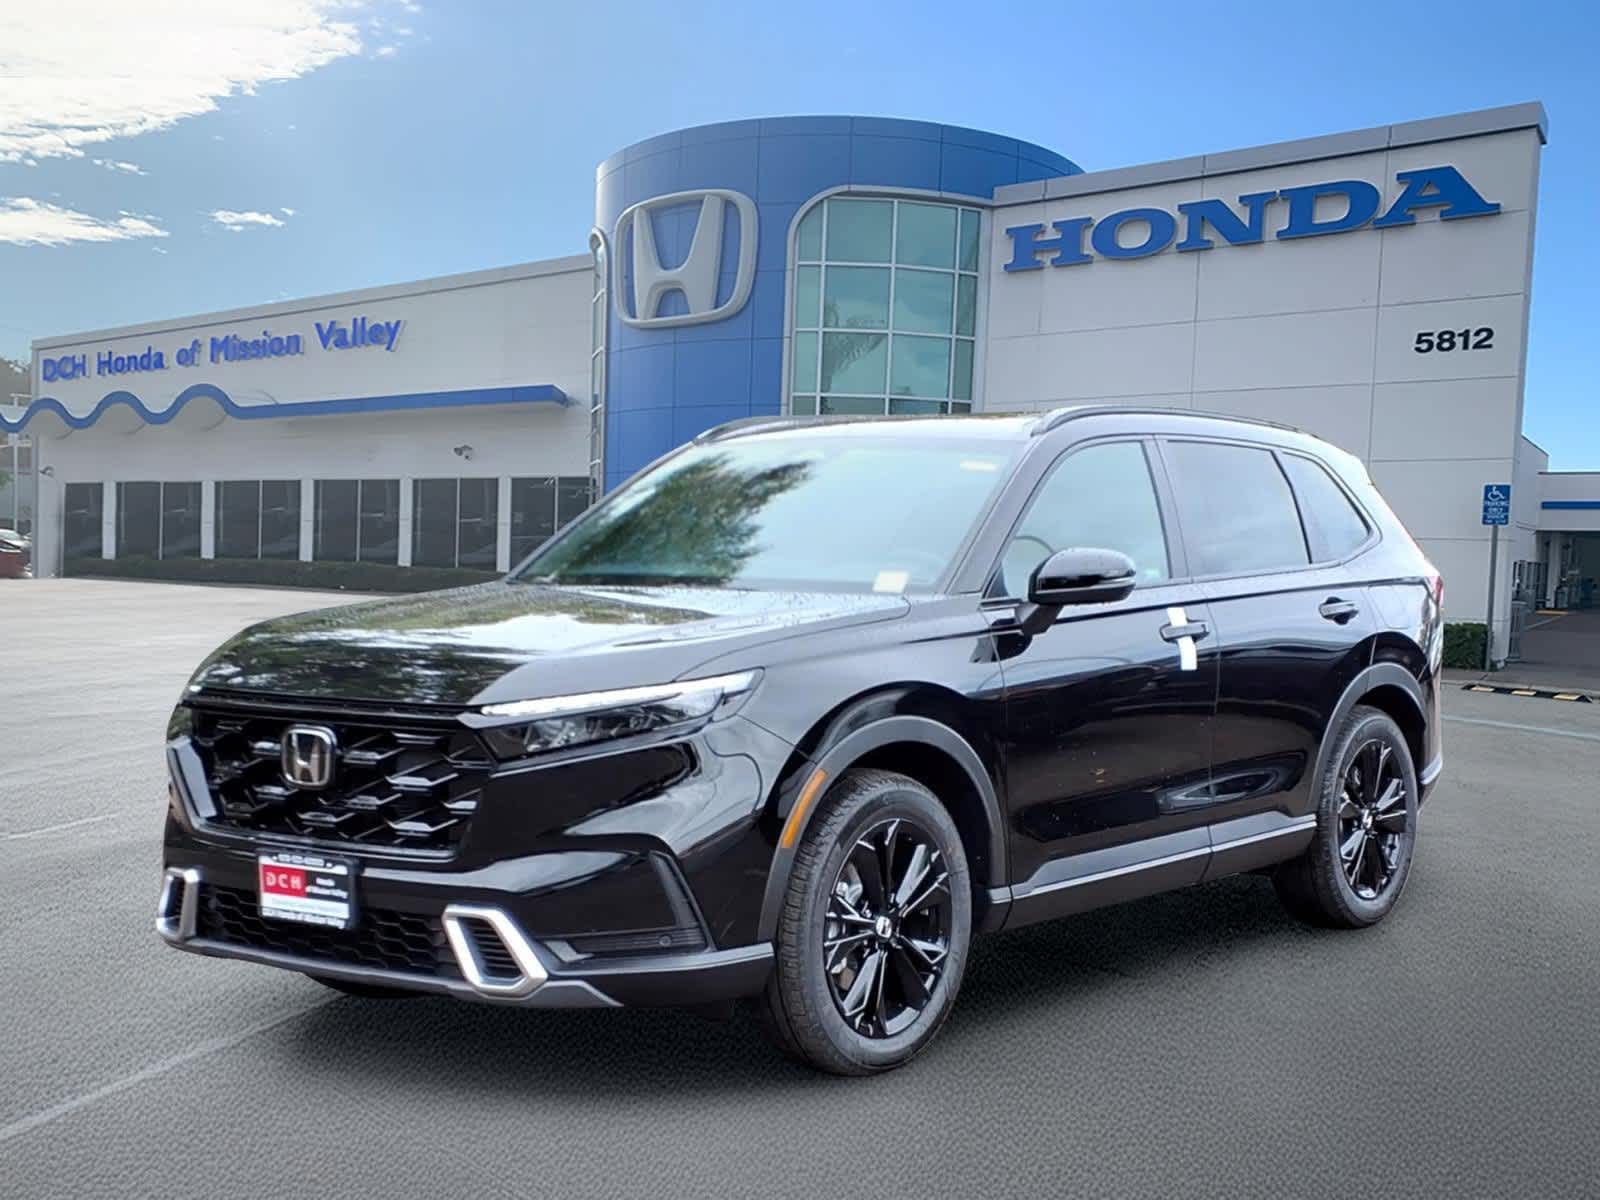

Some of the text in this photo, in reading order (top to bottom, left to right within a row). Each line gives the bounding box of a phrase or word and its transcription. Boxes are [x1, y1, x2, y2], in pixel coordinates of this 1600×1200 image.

[1003, 165, 1502, 272] HONDA
[42, 317, 400, 383] DCH Honda of Mission Valley
[1414, 327, 1494, 354] 5812
